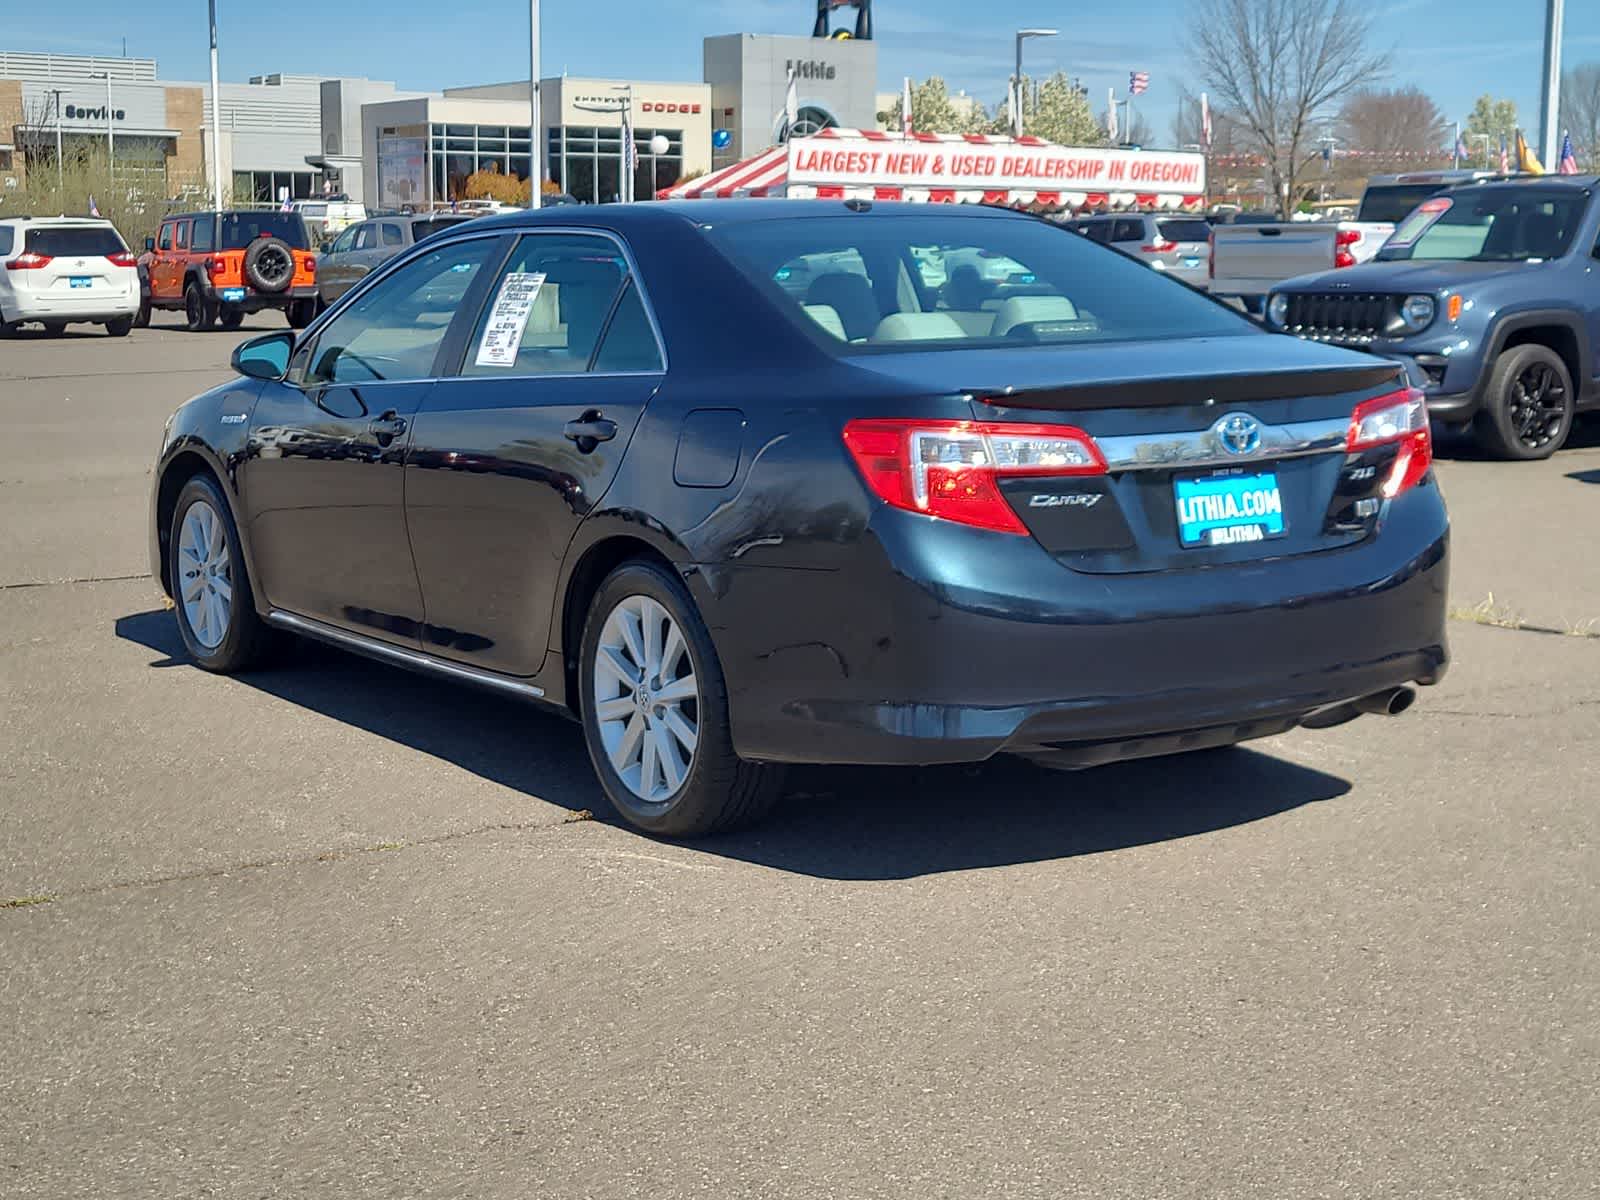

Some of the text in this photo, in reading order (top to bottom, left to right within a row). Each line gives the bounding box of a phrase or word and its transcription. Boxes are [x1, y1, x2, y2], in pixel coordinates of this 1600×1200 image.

[65, 104, 125, 120] Service
[642, 102, 701, 114] DODGE
[796, 149, 1200, 183] LARGEST NEW & USED DEALERSHIP IN OREGON!
[1178, 487, 1282, 525] LITHIA.COM
[1224, 524, 1264, 543] LITHIA
